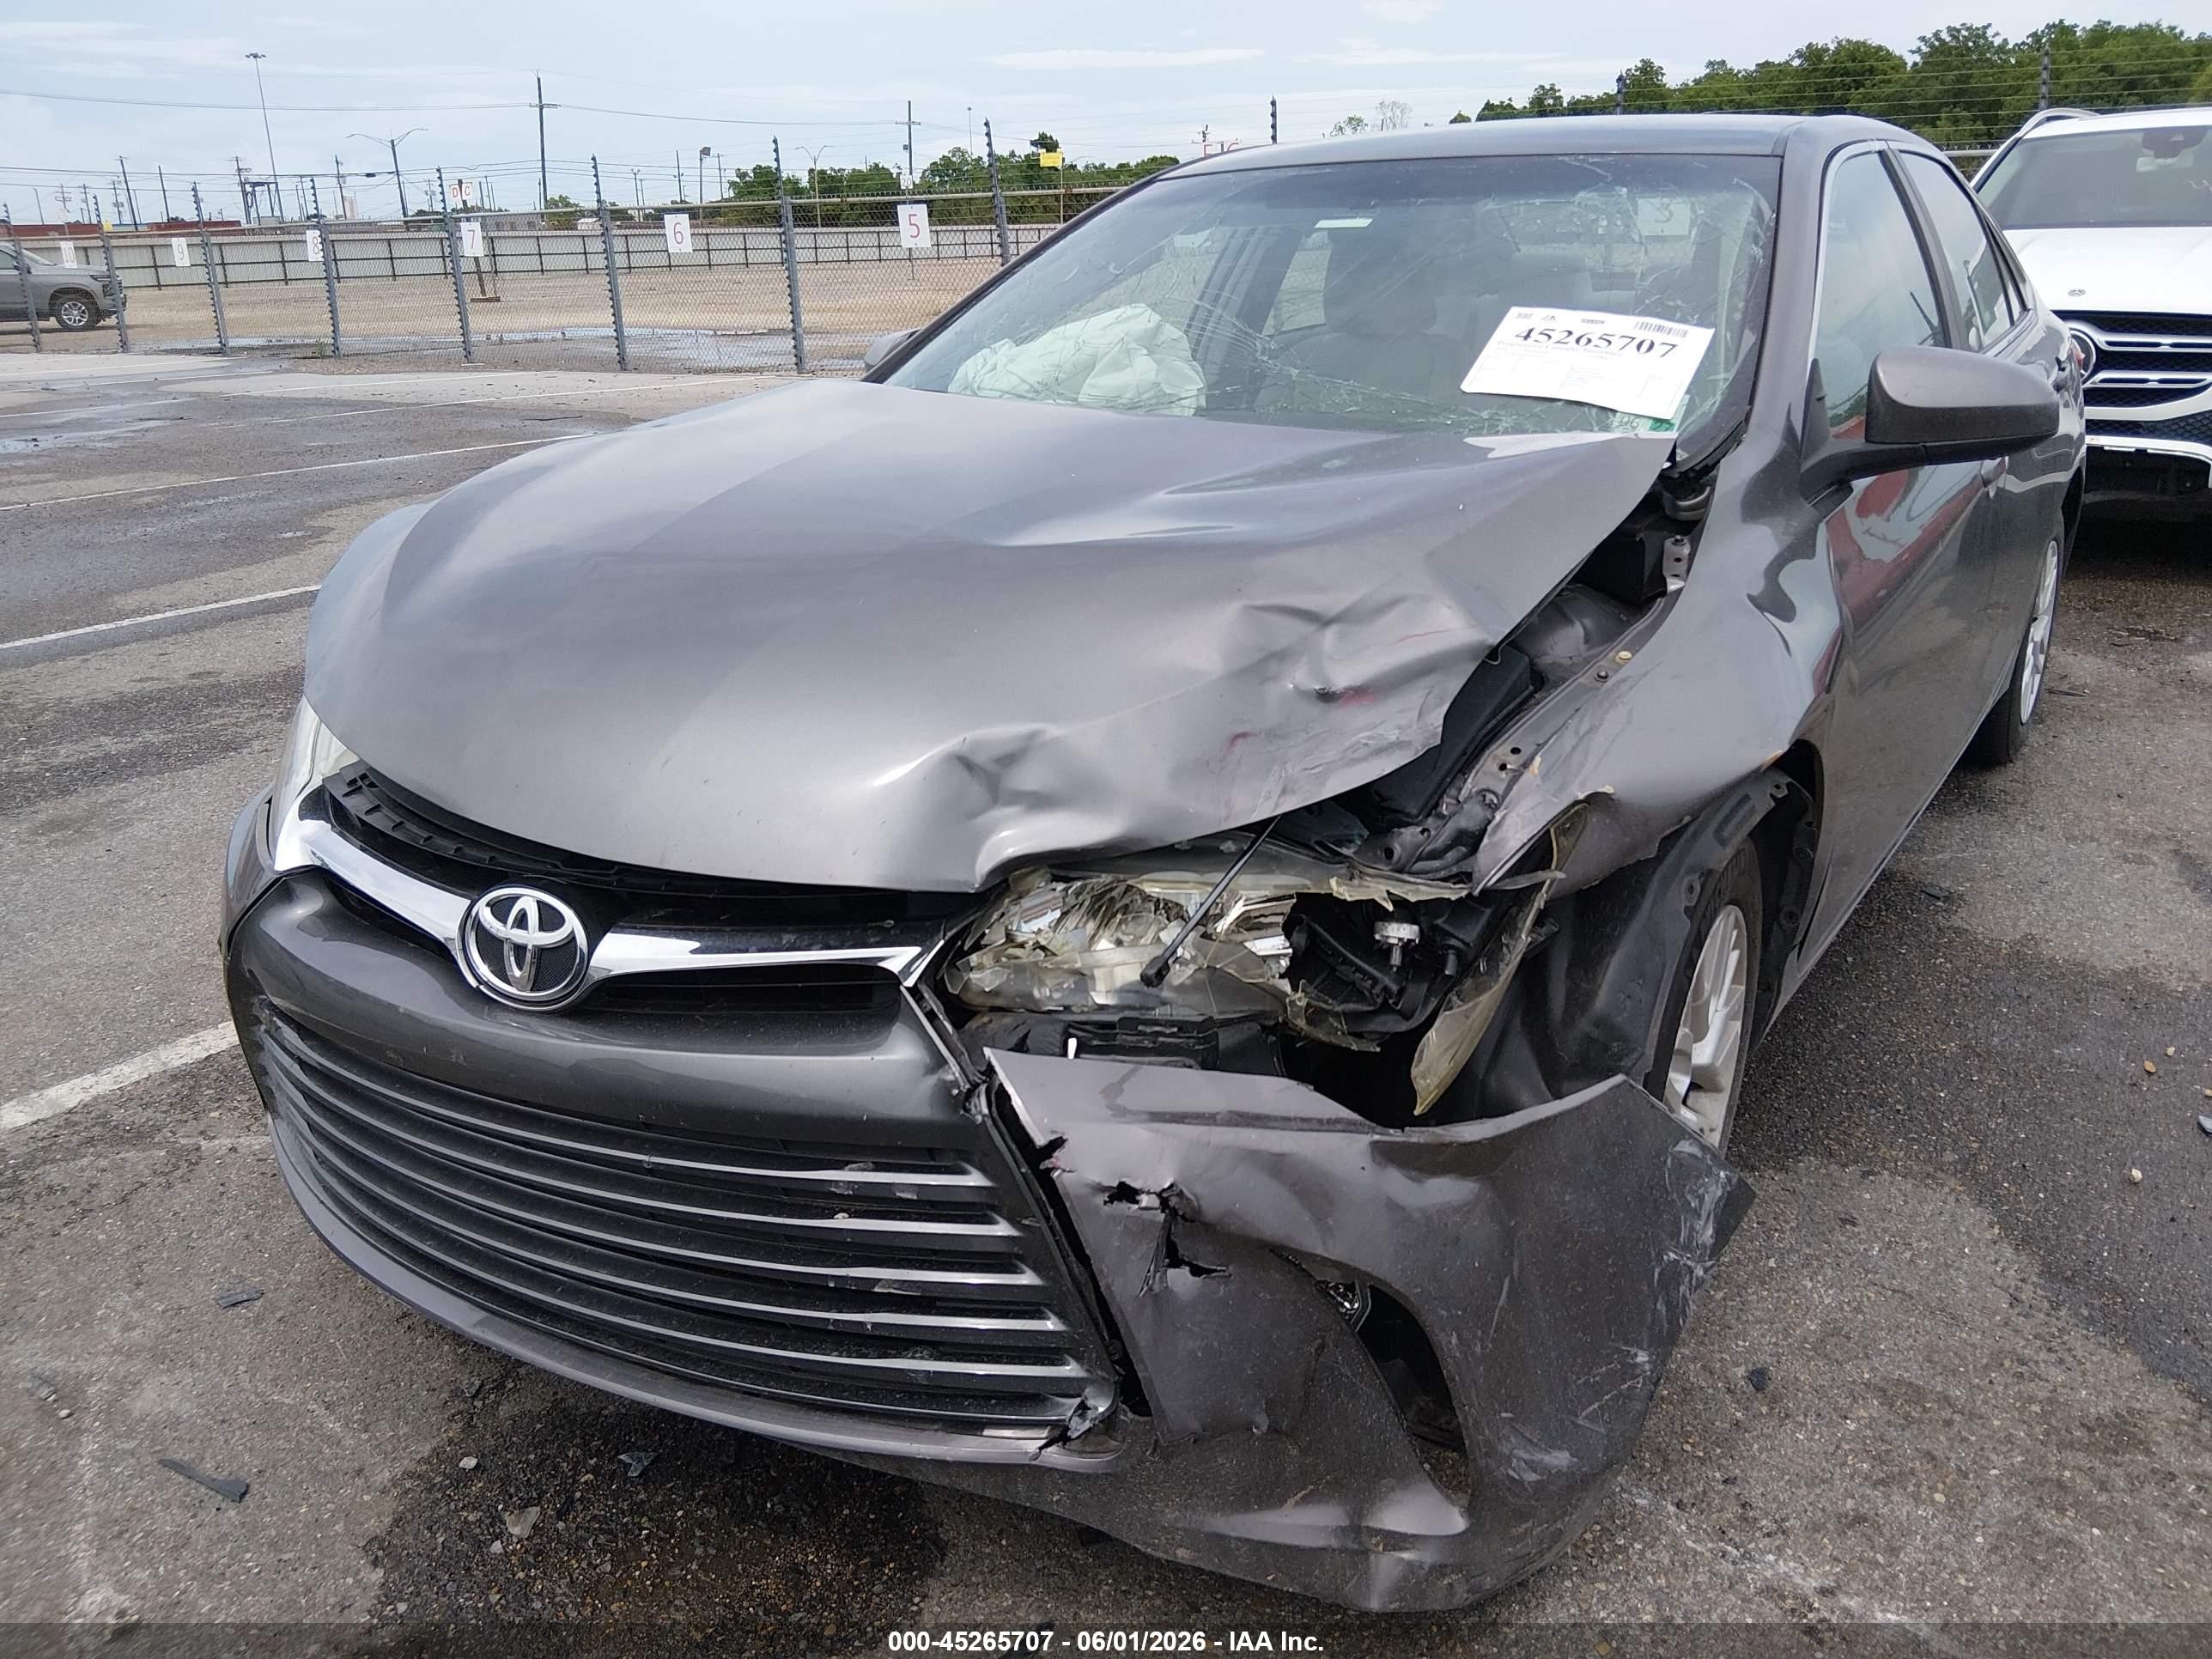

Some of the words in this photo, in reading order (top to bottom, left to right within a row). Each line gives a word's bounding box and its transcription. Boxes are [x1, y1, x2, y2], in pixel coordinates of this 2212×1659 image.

[452, 186, 459, 198] D
[465, 185, 471, 196] C
[673, 222, 684, 245] 6
[908, 214, 920, 238] 5
[312, 235, 320, 255] 8
[467, 229, 476, 250] 7
[63, 246, 75, 262] 10
[177, 243, 185, 261] 9
[1514, 326, 1679, 359] 45265707
